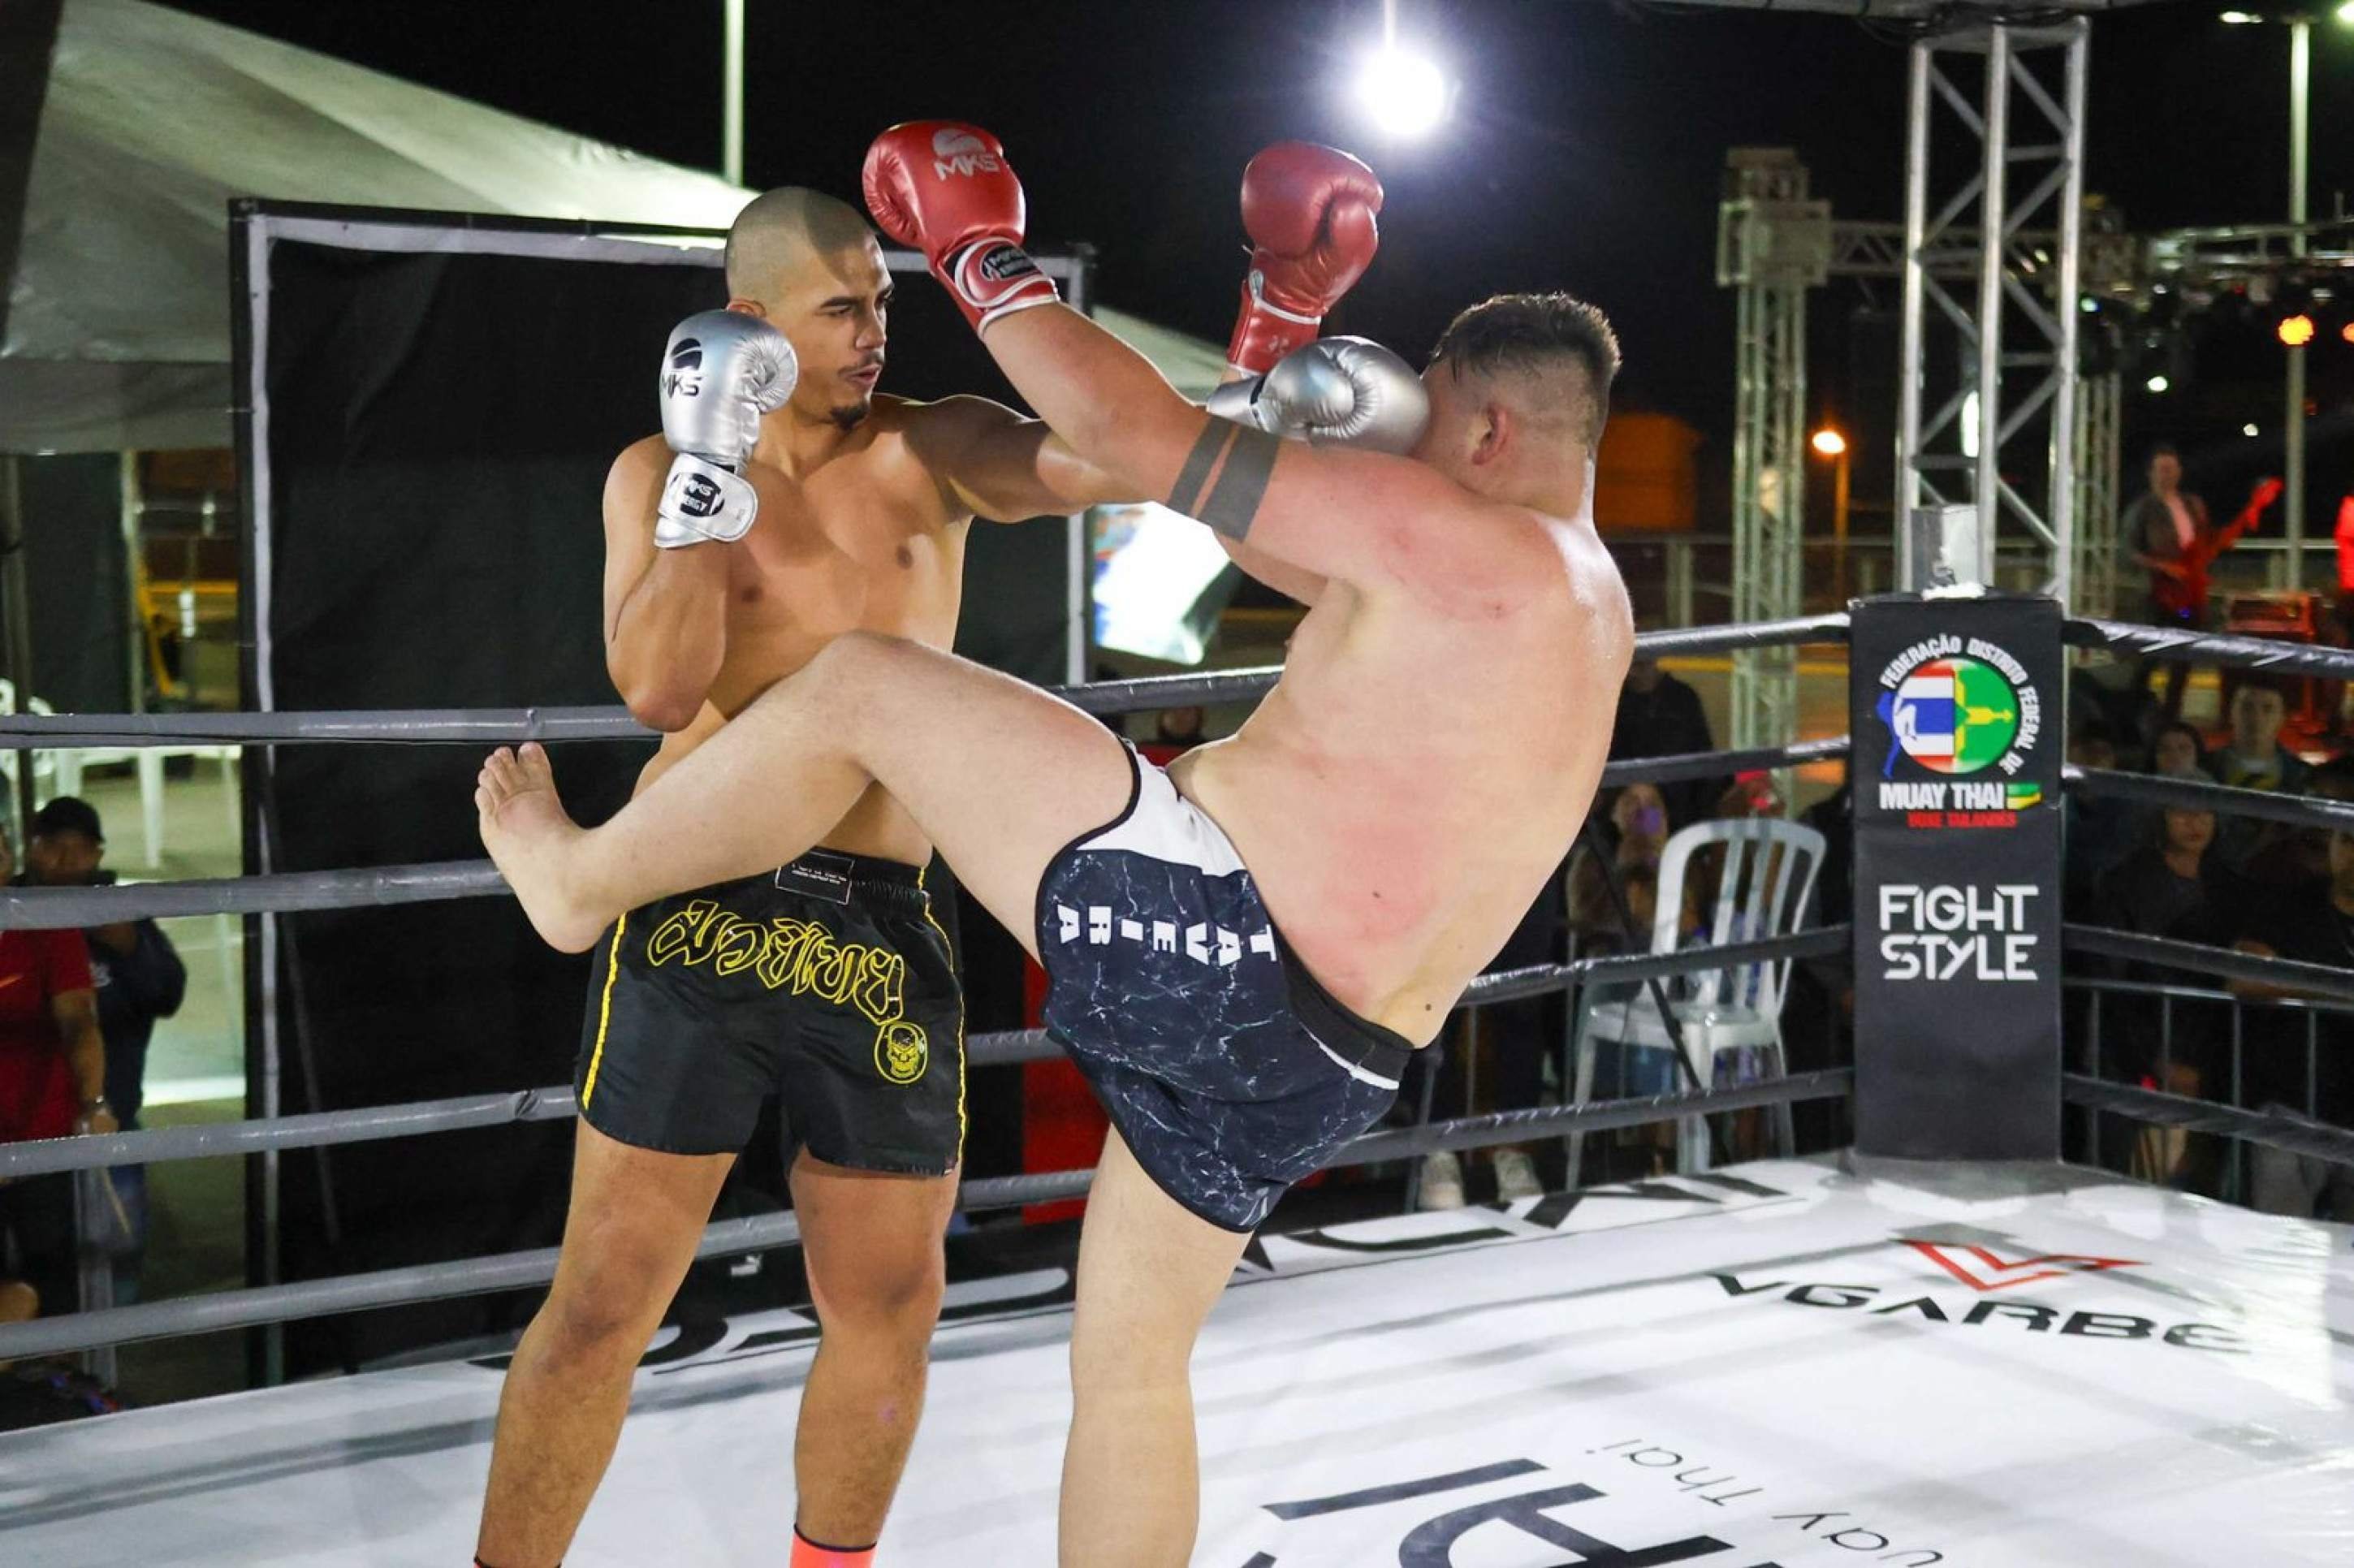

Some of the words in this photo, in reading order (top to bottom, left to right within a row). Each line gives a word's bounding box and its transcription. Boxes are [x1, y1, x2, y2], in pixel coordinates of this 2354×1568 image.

[934, 154, 1000, 181] MKS
[1880, 633, 1962, 689] FEDERAÇÃO
[1967, 638, 2028, 685] DISTRITO
[2015, 685, 2041, 749] FEDERAL
[1879, 783, 1946, 810] MUAY
[1950, 782, 2004, 810] THAI
[1879, 885, 2039, 931] FIGHT
[1057, 904, 1276, 967] TAVEIRA
[1881, 935, 2038, 980] STYLE
[1586, 1439, 1763, 1506] Thai
[1772, 1512, 1943, 1568] uay
